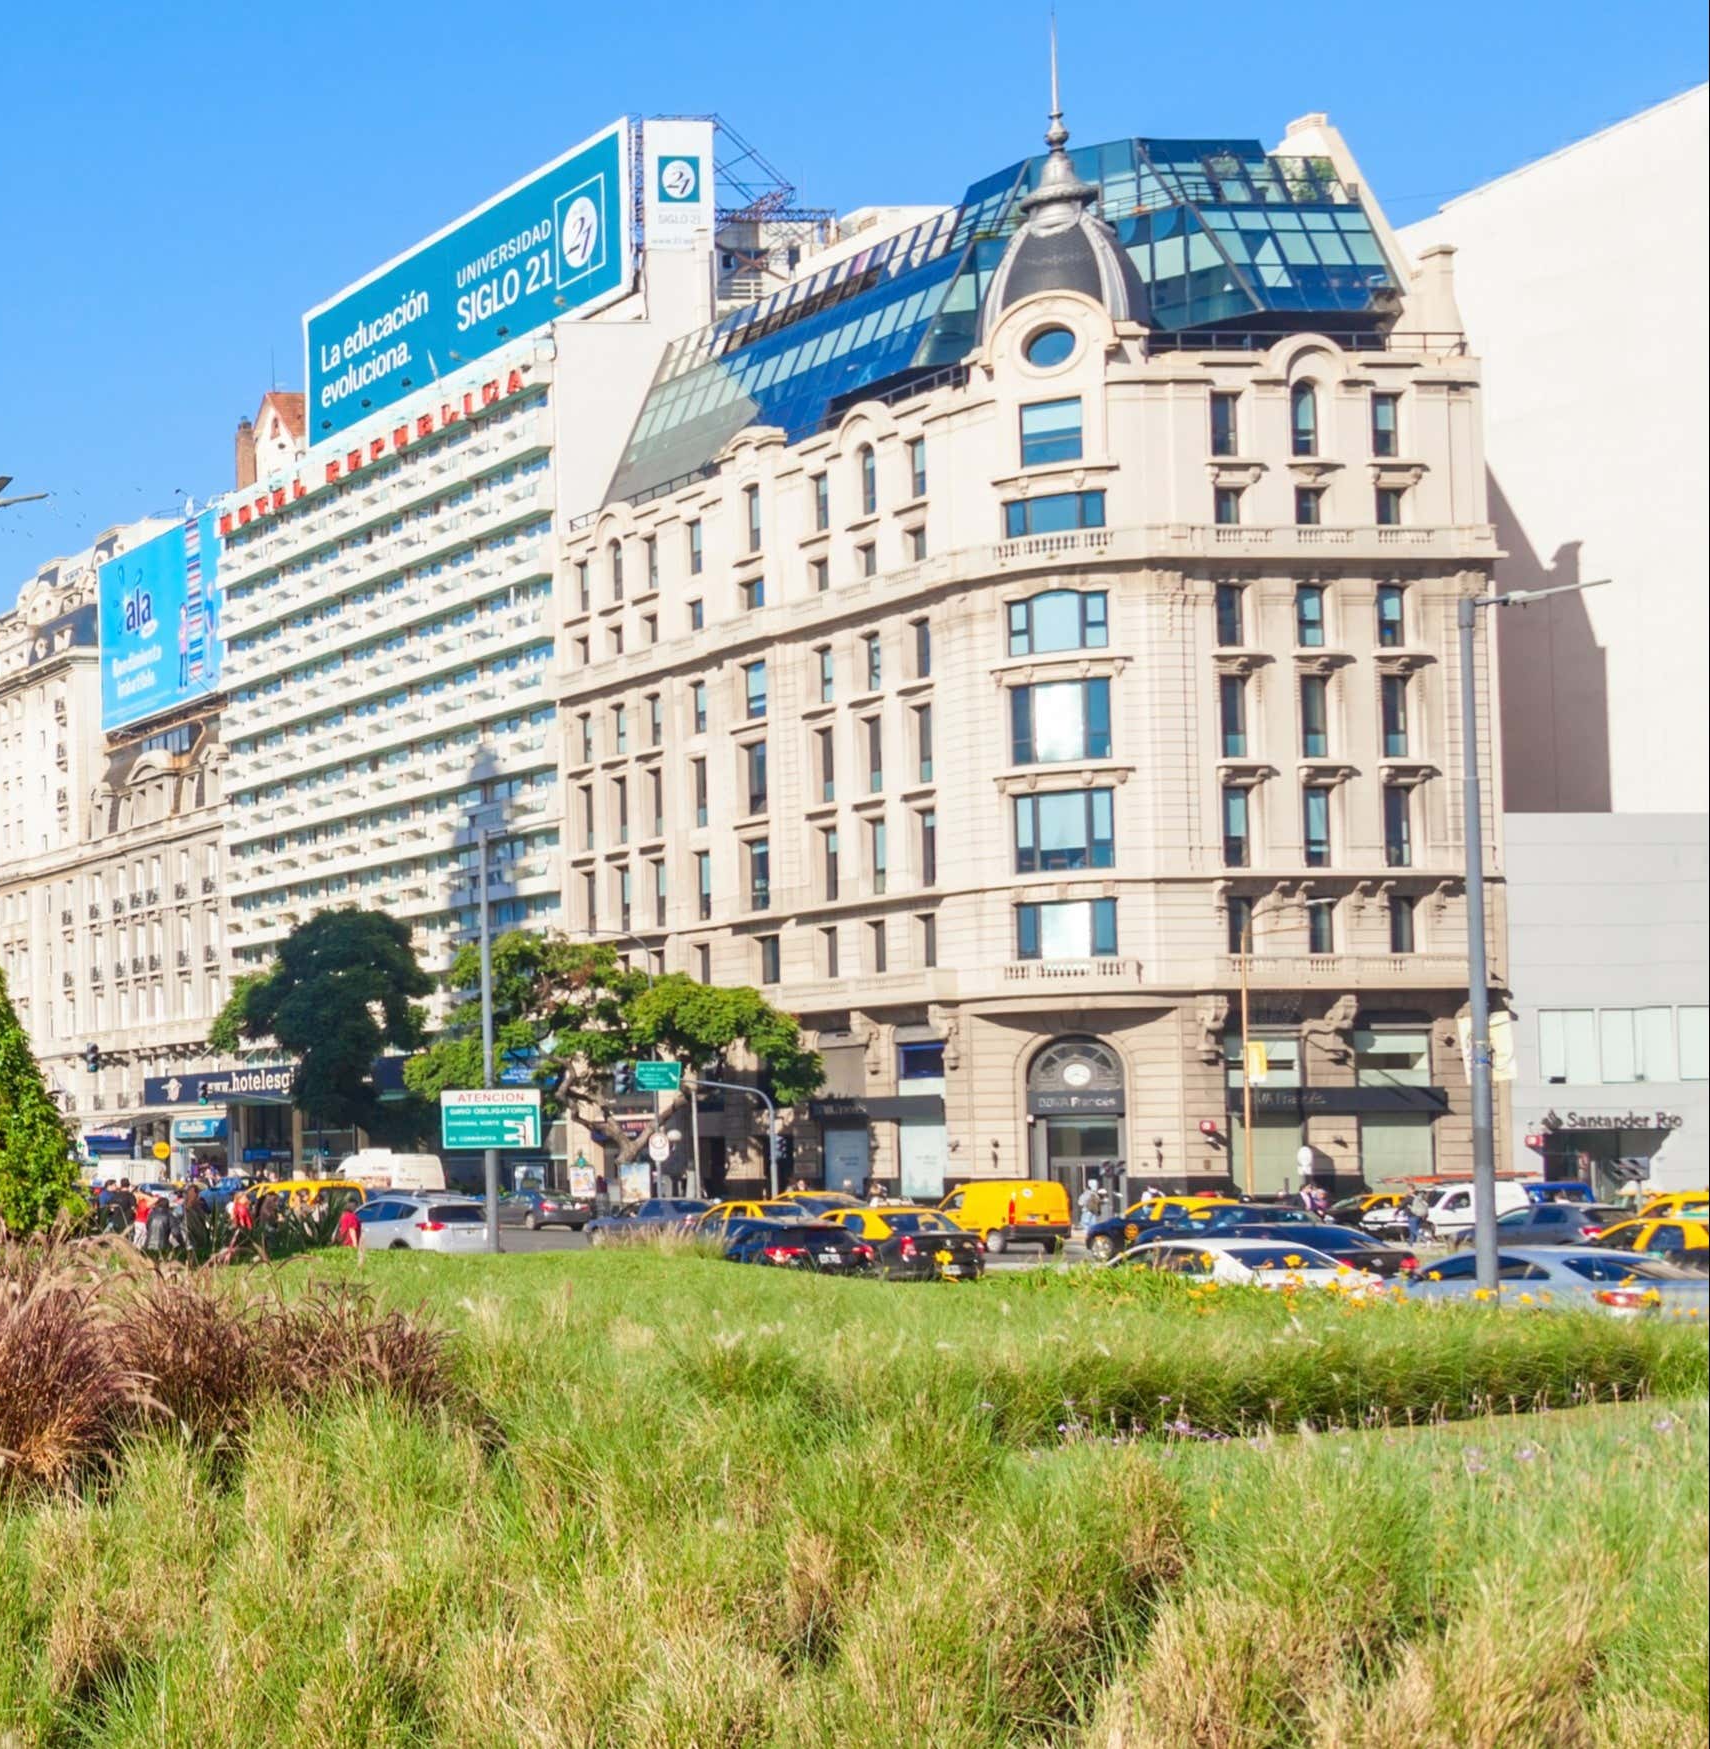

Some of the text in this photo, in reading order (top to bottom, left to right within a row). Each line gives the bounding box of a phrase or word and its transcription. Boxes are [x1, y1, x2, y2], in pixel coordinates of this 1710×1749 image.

[456, 219, 552, 289] UNIVERSIDAD
[456, 249, 553, 332] SIGLO 21
[321, 289, 429, 373] La educación
[321, 342, 412, 408] evoluciona.
[219, 368, 525, 535] HOTEL REPUBLICA
[457, 1093, 525, 1102] ATENCION
[1567, 1110, 1650, 1128] Santander
